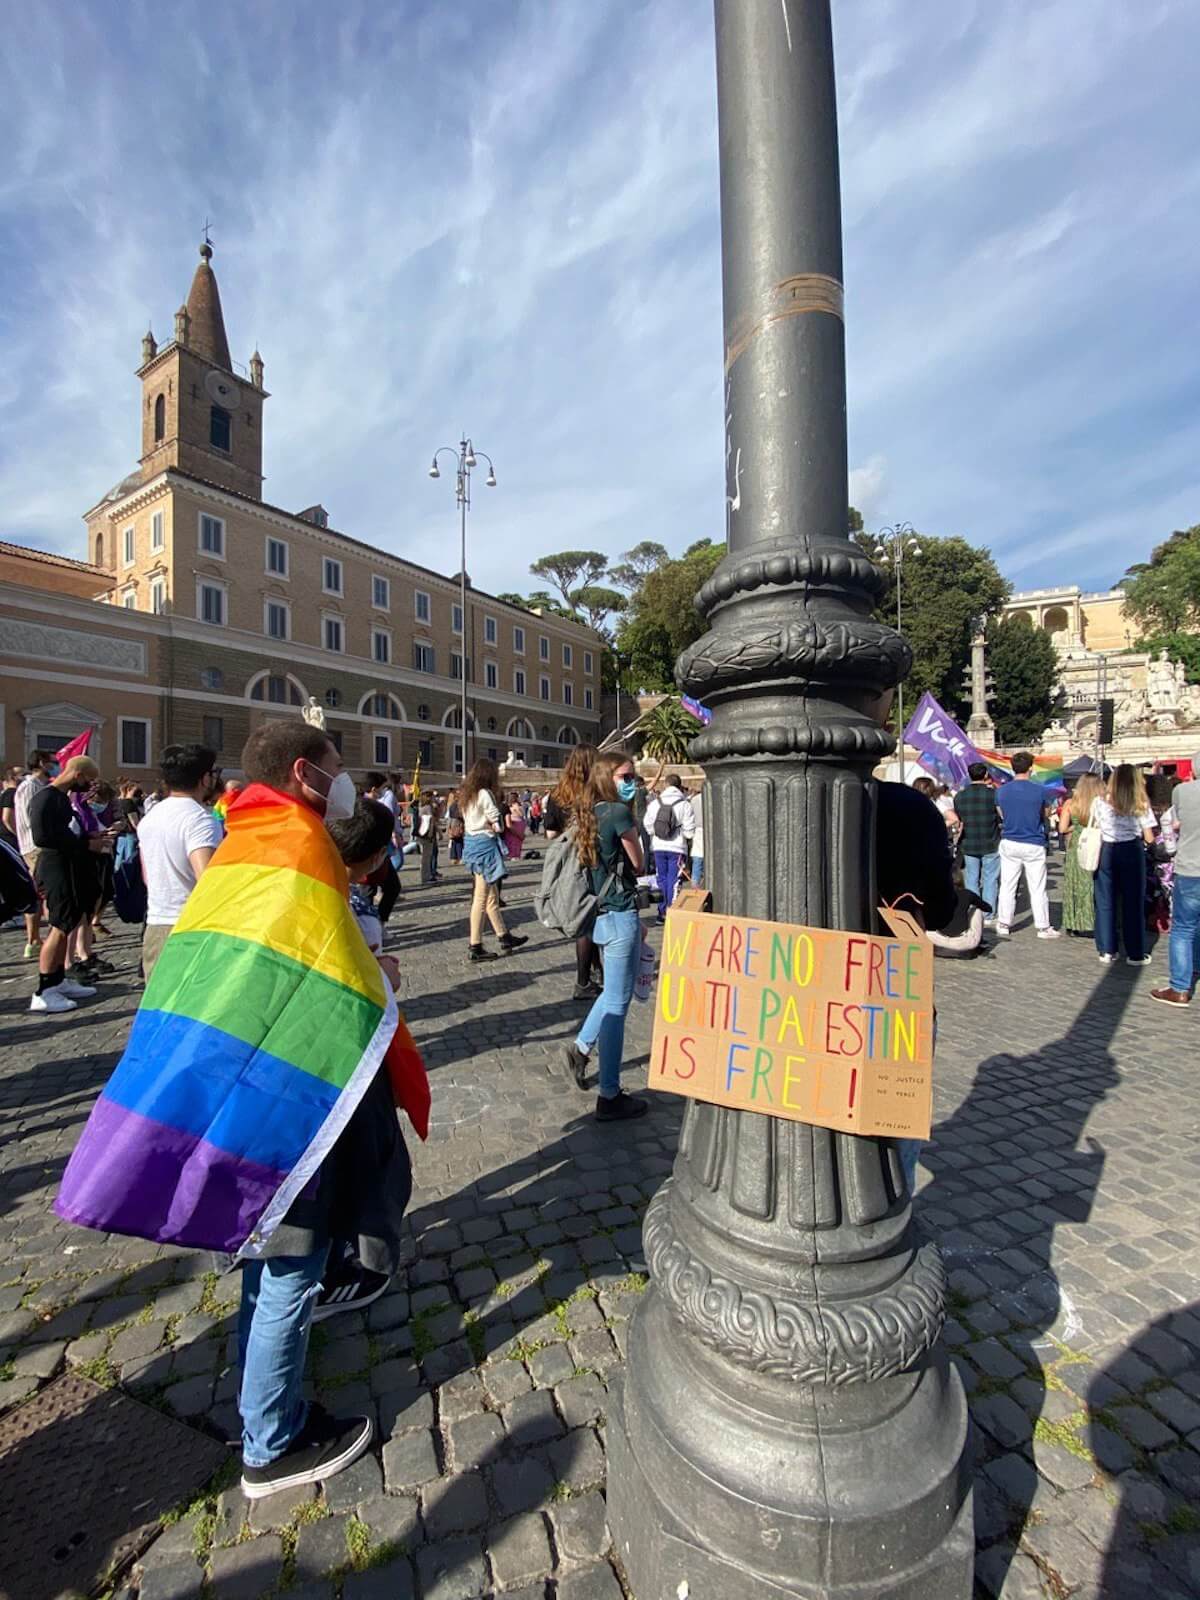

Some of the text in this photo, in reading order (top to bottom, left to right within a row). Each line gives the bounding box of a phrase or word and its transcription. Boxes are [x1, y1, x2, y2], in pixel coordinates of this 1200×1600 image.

[665, 916, 922, 1000] WE ARE NOT FREE
[659, 1035, 697, 1080] IS
[661, 972, 930, 1064] UNTIL PALESTINE
